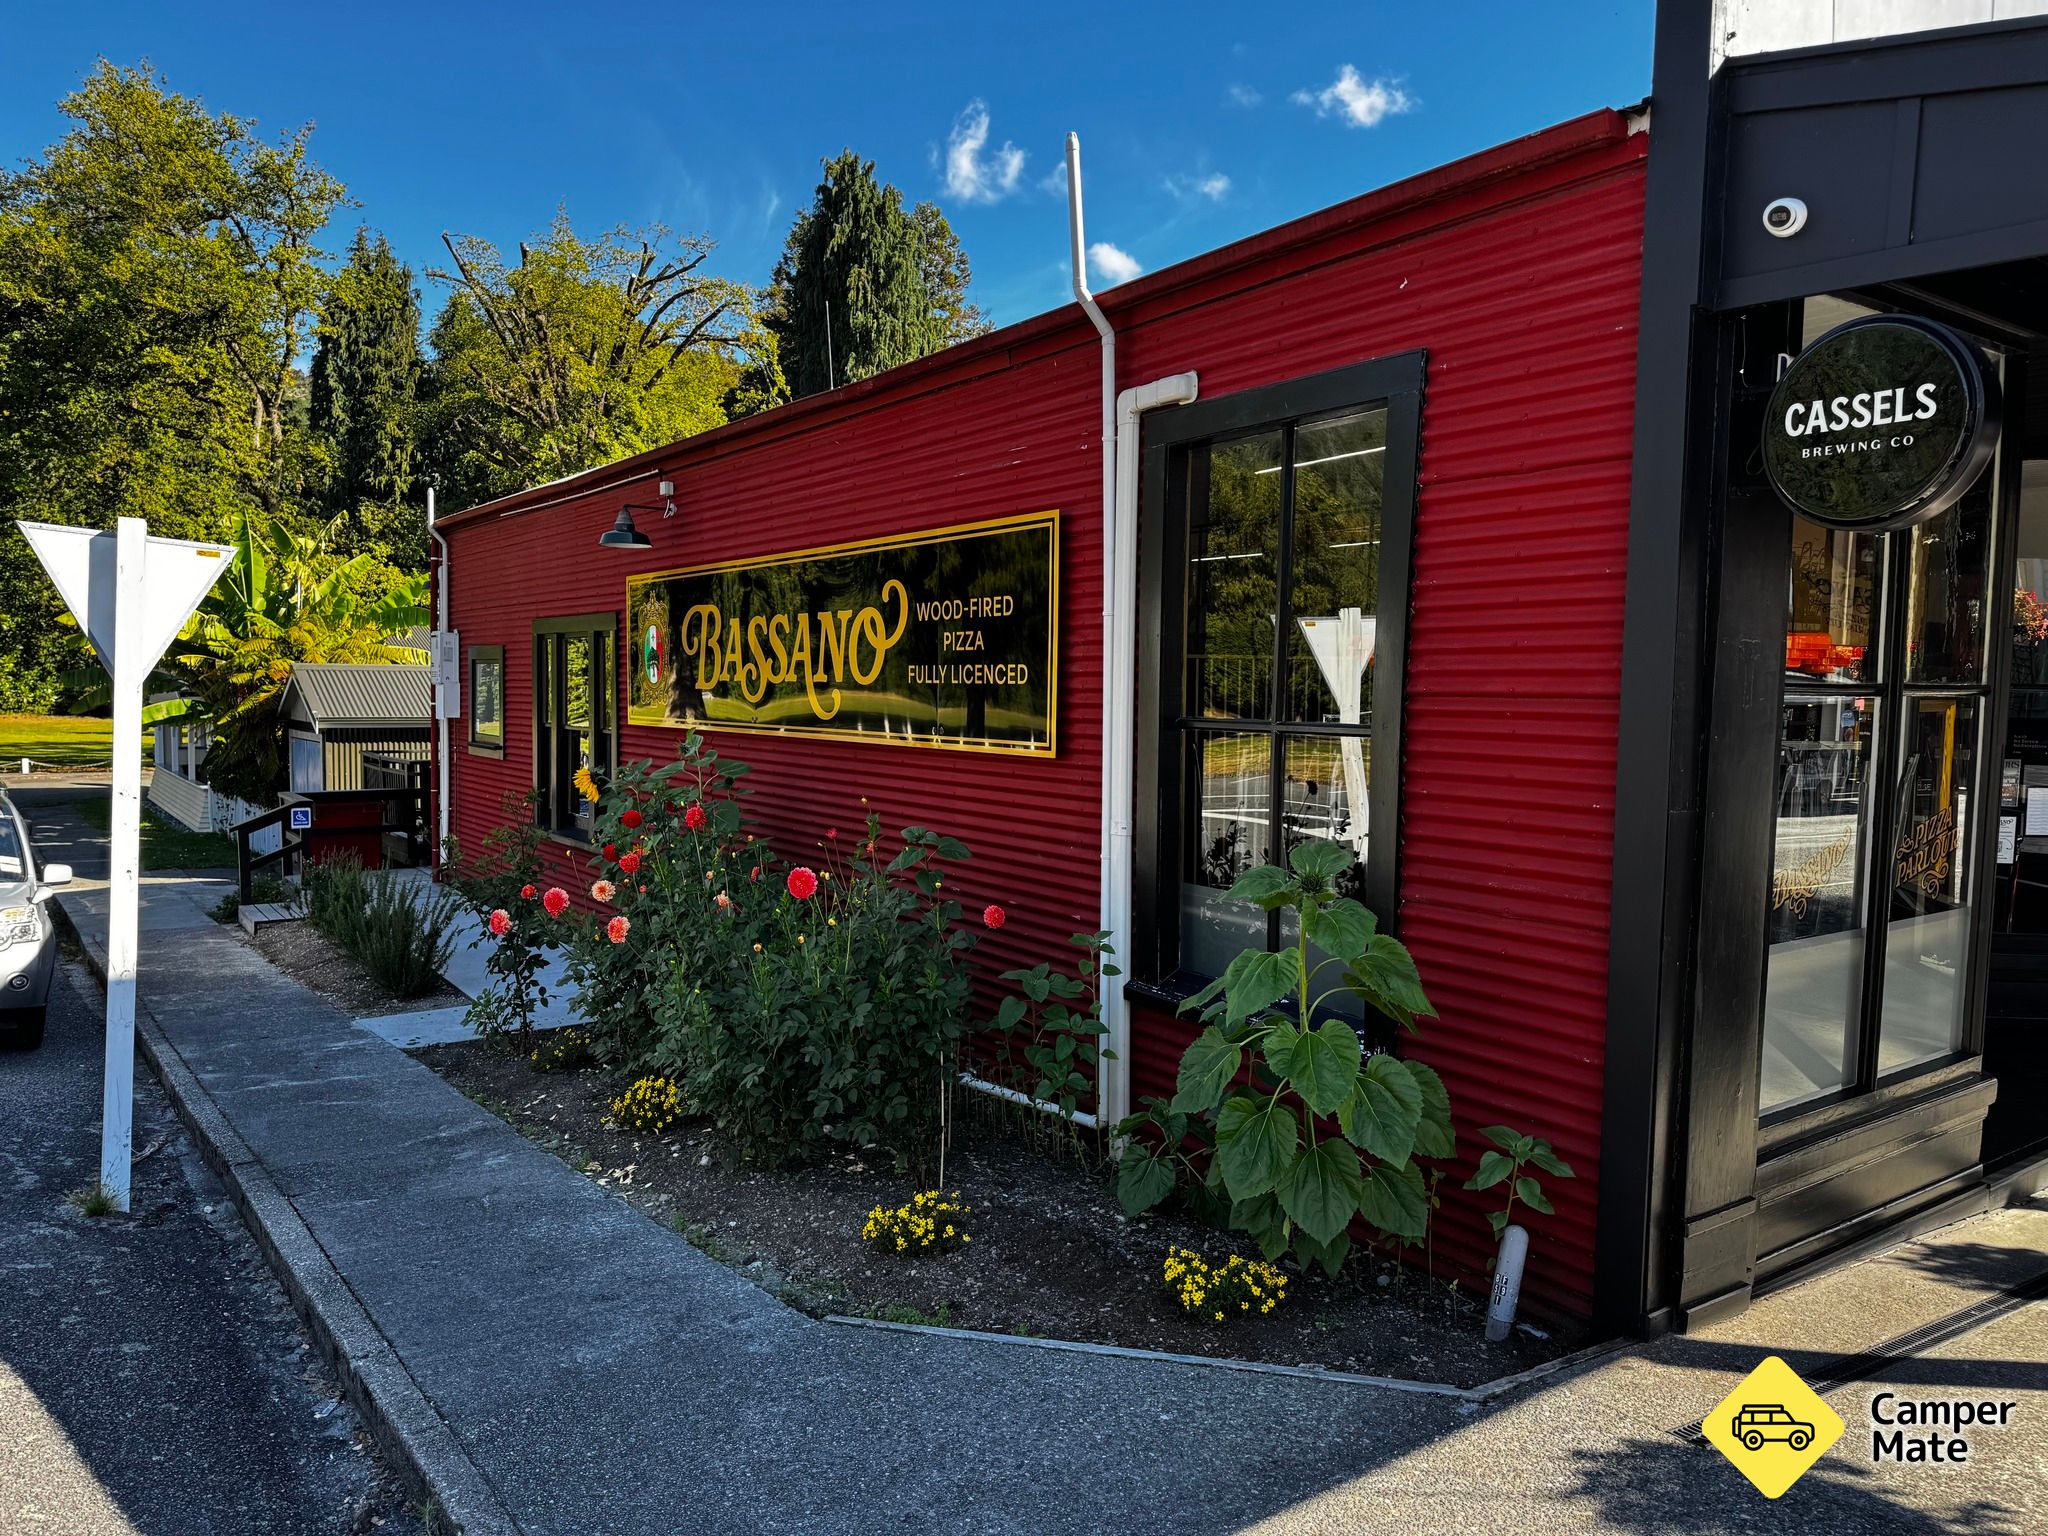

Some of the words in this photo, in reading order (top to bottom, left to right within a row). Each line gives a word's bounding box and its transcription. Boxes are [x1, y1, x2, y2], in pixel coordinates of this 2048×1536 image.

[1784, 382, 1938, 438] CASSELS
[1801, 438, 1882, 460] BREWING
[1890, 434, 1915, 449] CO
[916, 594, 1014, 623] WOOD-FIRED
[681, 578, 909, 720] BASSANO
[943, 630, 985, 653] PIZZA
[907, 664, 948, 685] FULLY
[951, 663, 1029, 686] LICENCED
[1911, 805, 1953, 849] PIZZA
[1896, 825, 1961, 888] PARLOUR
